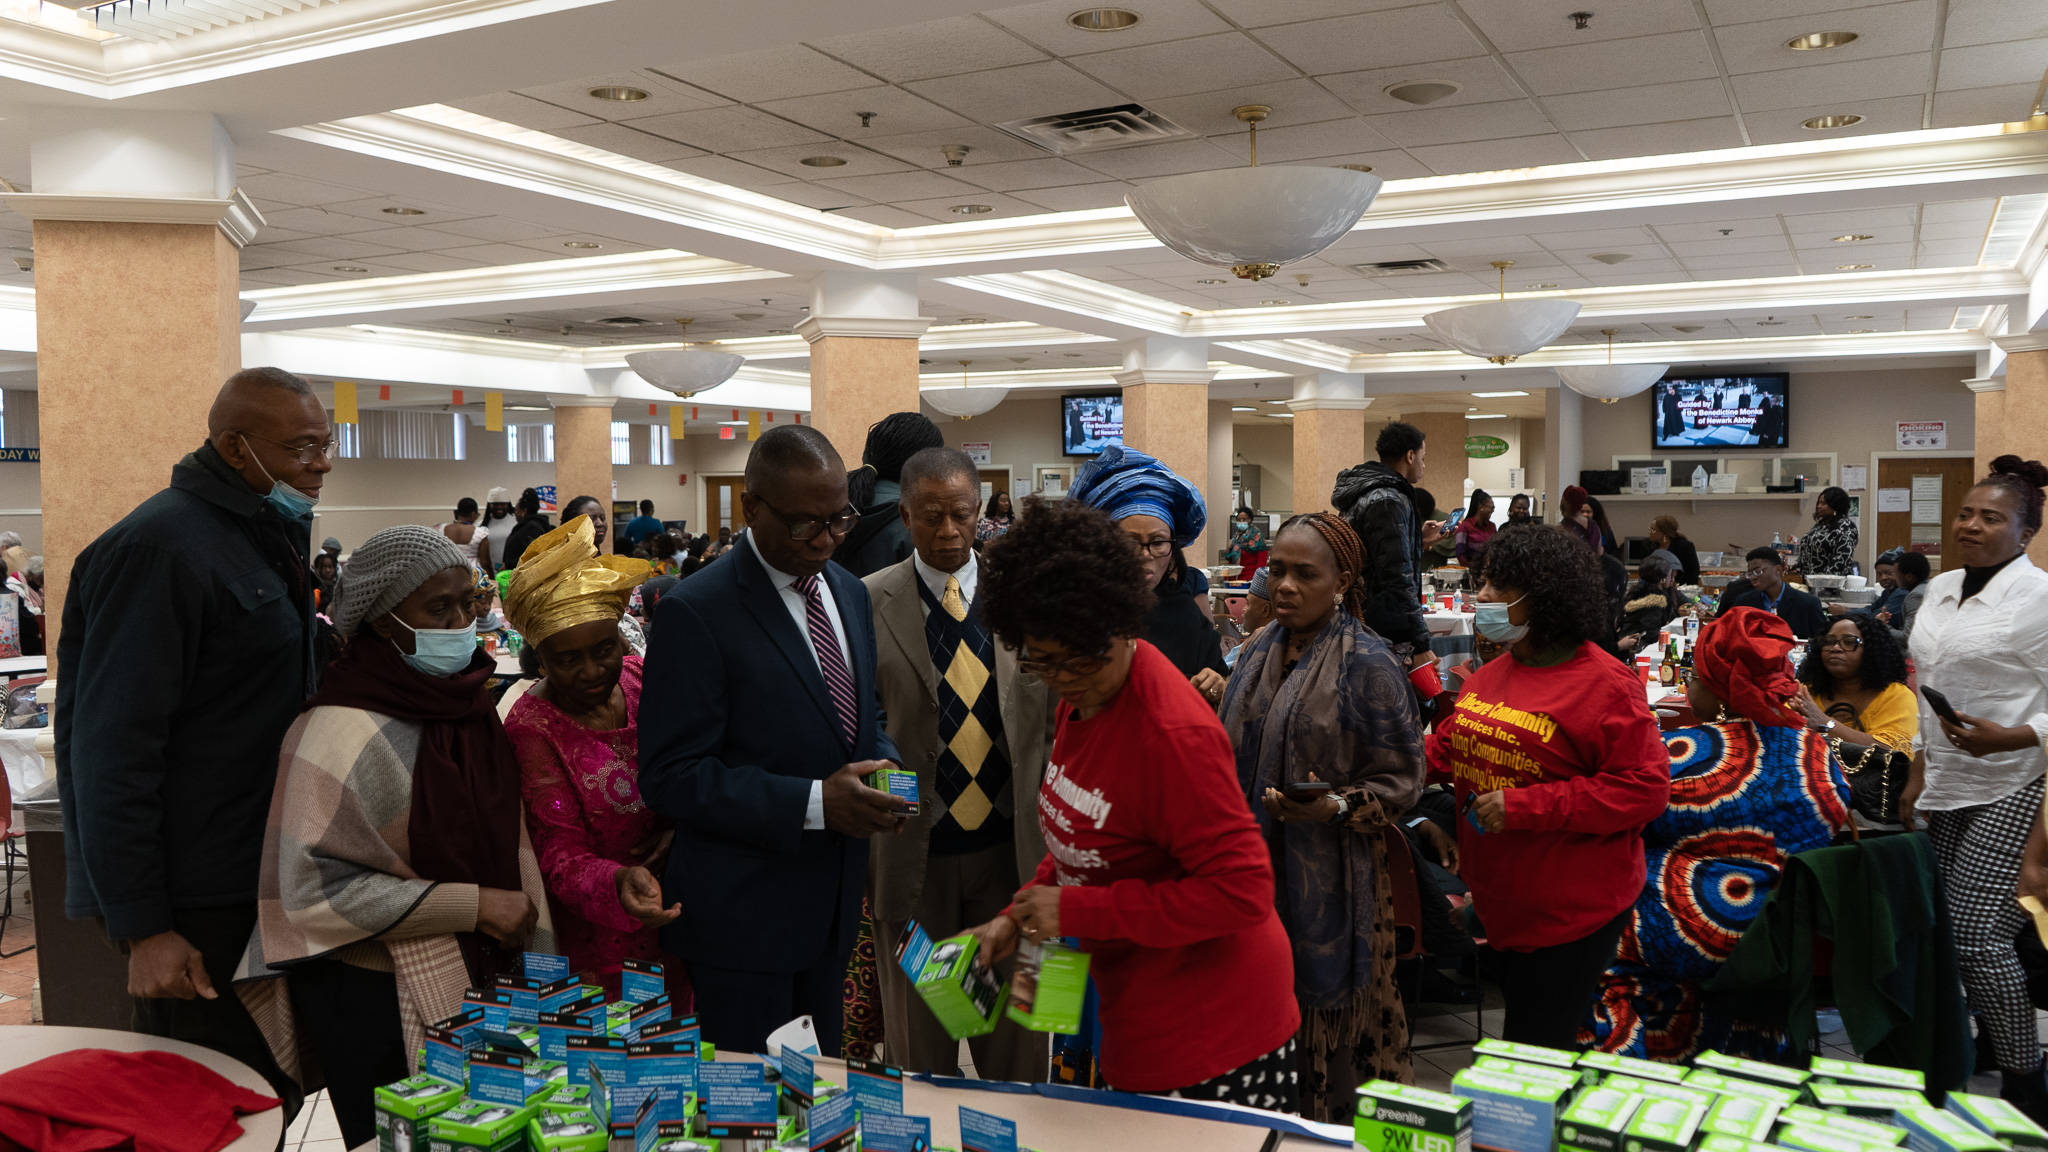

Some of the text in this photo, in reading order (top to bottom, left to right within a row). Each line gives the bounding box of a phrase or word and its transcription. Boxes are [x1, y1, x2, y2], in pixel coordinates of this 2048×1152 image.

[1677, 400, 1712, 409] Guided by
[1698, 408, 1738, 416] Benedictine
[0, 450, 40, 460] DAY W
[1455, 692, 1558, 743] Lifecare Community
[1455, 713, 1521, 746] Services Inc.
[1470, 734, 1544, 778] Communities,
[1376, 1107, 1426, 1126] greenlite
